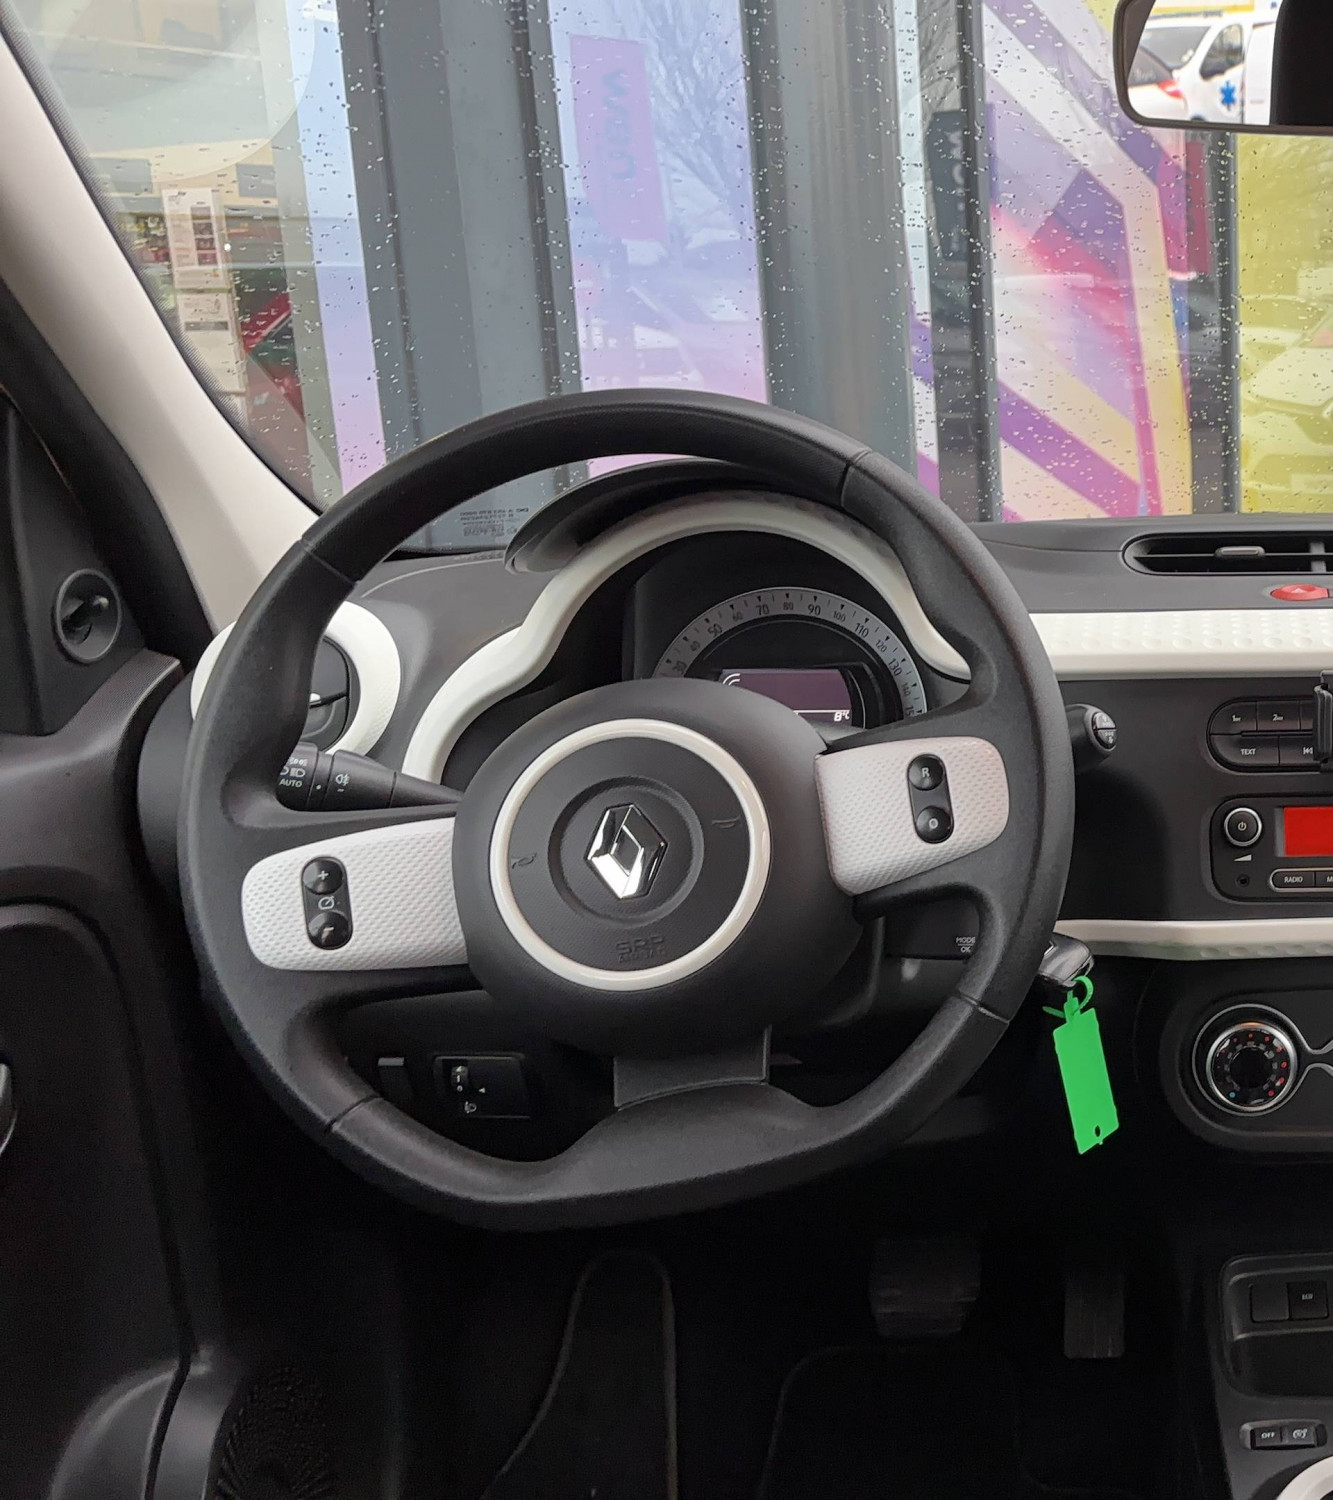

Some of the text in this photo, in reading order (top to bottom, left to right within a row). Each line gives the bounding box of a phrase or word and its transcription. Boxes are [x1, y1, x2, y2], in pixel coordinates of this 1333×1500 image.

[755, 604, 770, 616] 70
[807, 604, 821, 617] 90
[833, 611, 846, 623] 100
[707, 623, 723, 638] 50
[854, 622, 869, 638] 110
[875, 639, 888, 653] 120
[888, 658, 902, 677] 130
[1241, 748, 1256, 756] TEXT
[921, 766, 930, 777] R
[279, 778, 303, 788] AUTO
[955, 936, 976, 944] MODE
[1261, 1431, 1275, 1439] OFF
